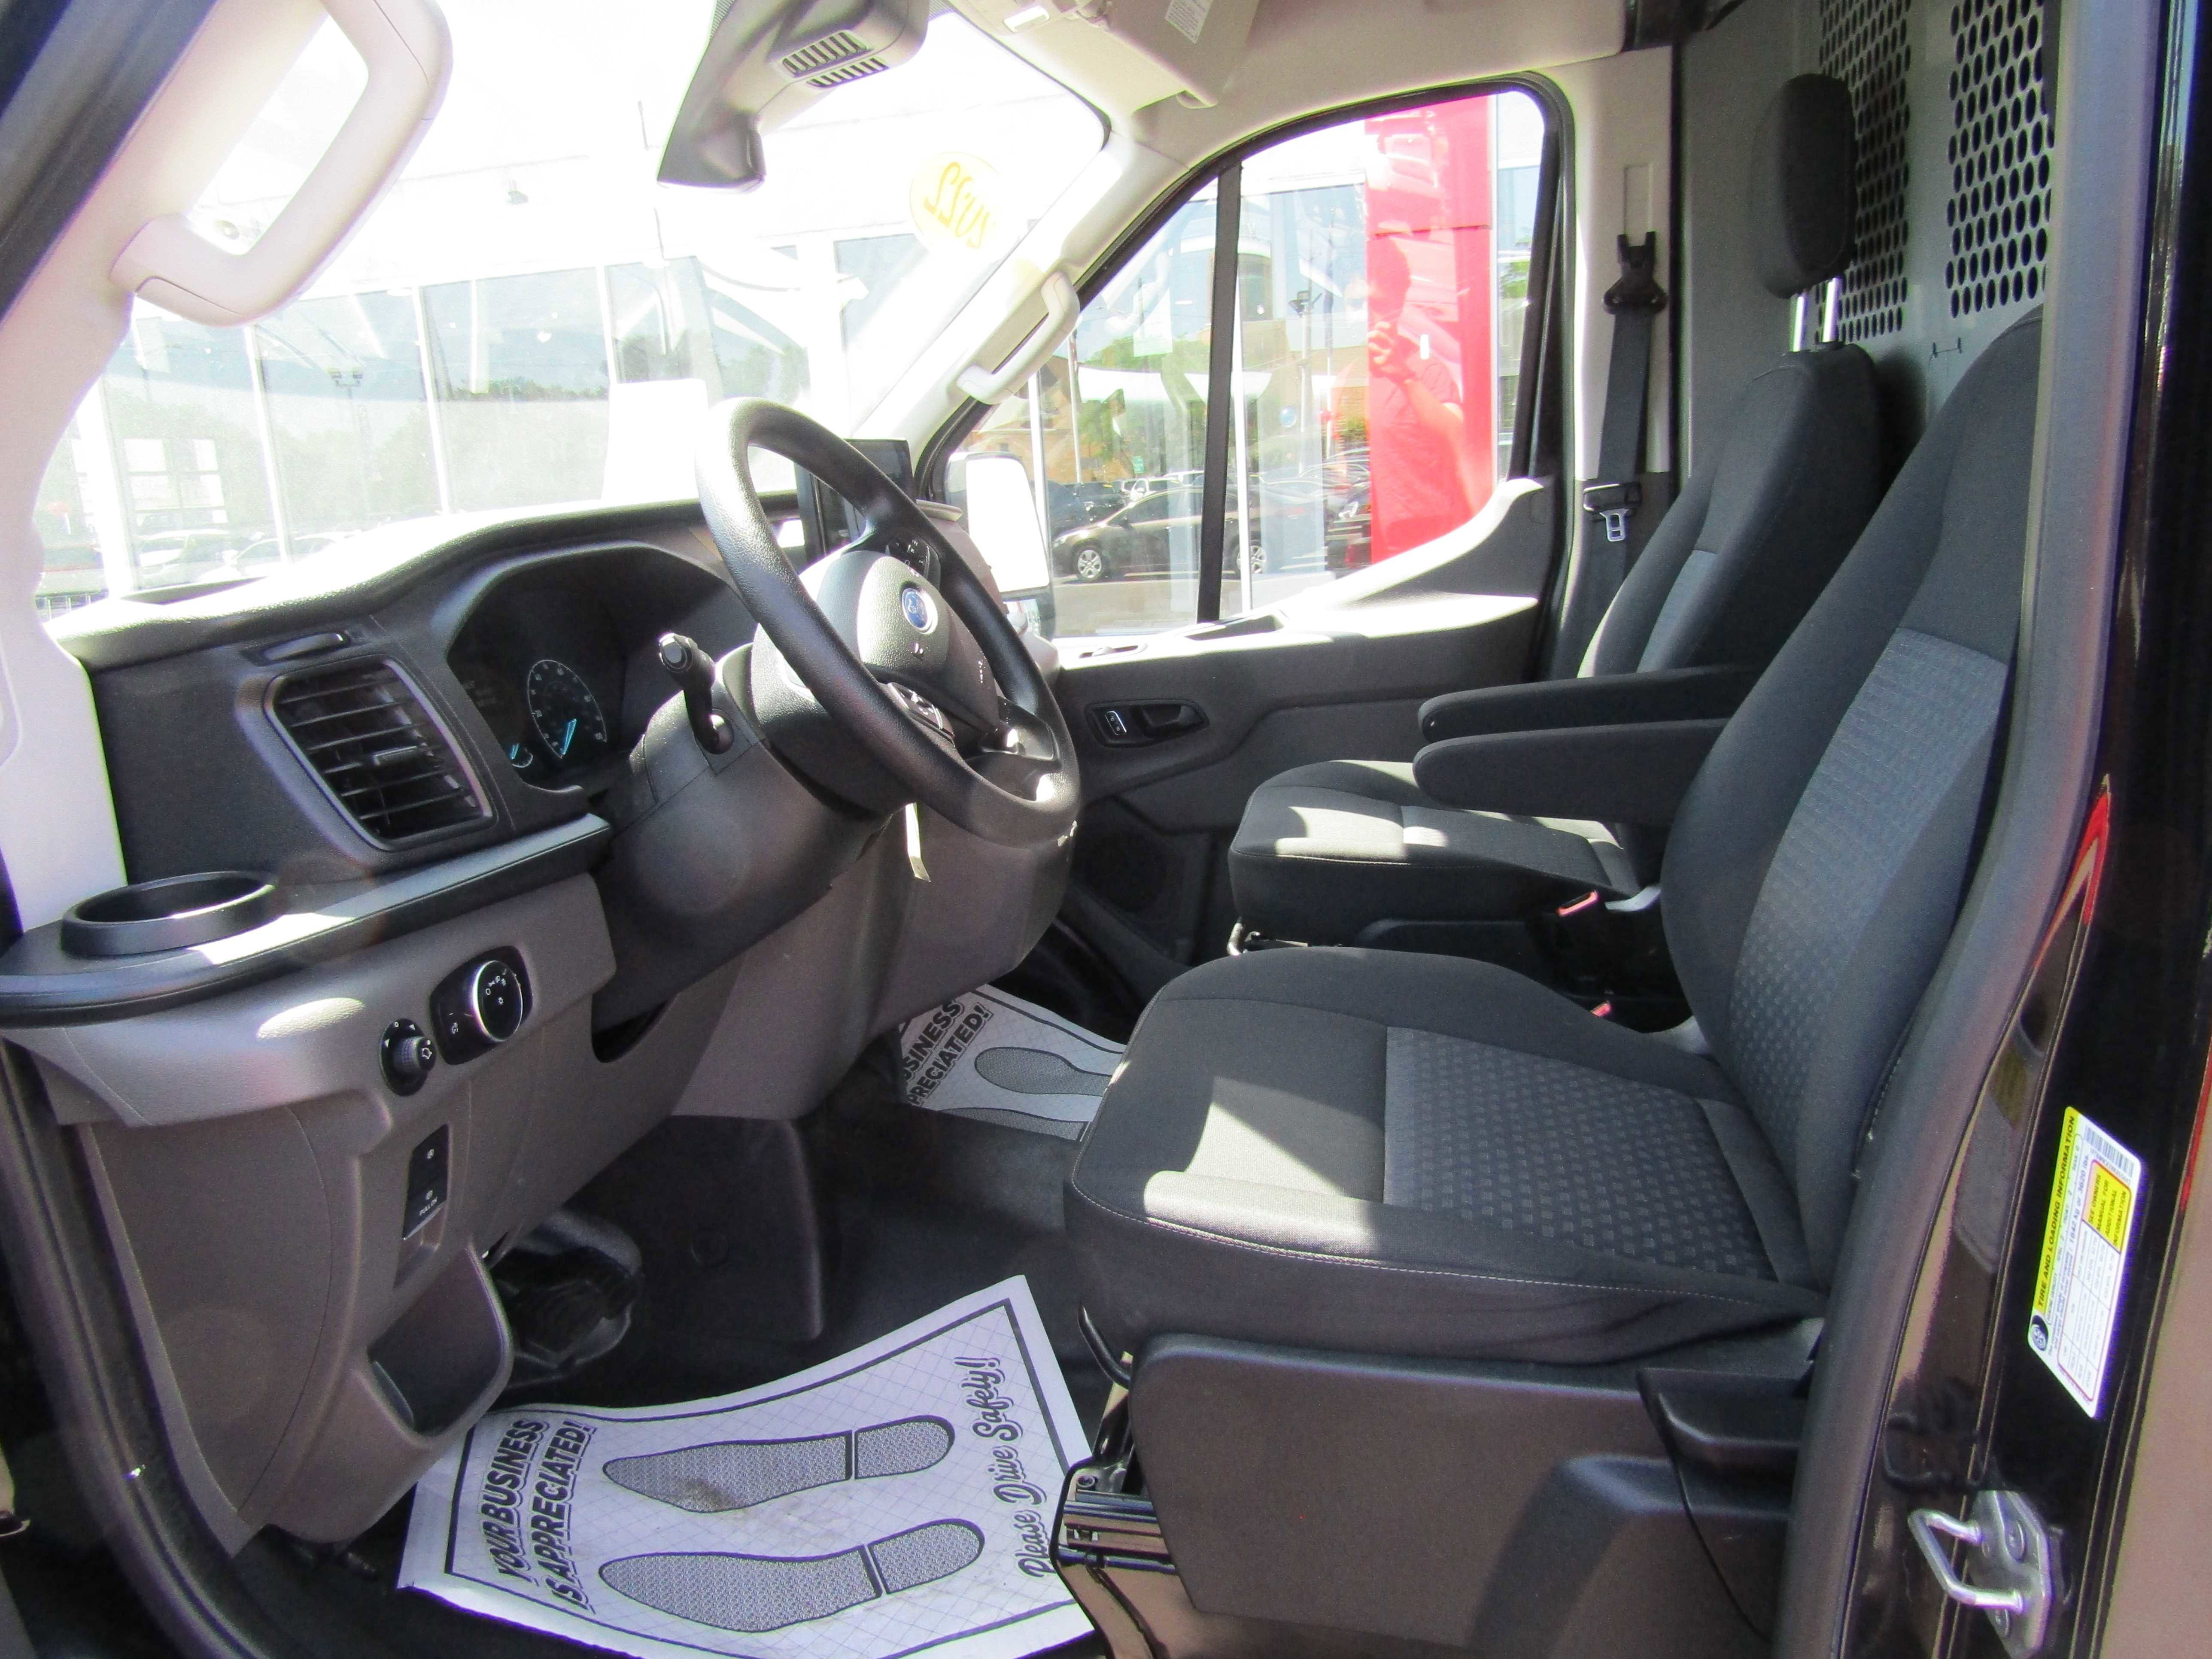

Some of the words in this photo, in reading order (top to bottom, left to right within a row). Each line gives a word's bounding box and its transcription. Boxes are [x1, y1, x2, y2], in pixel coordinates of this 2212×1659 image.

[2038, 1279, 2046, 1310] TIRE
[2042, 1252, 2051, 1280] AND
[2047, 1199, 2060, 1254] LOADING
[2056, 1114, 2075, 1199] INFORMATION
[2069, 1219, 2077, 1244] 1642
[2077, 1168, 2086, 1194] 3620
[2090, 1172, 2101, 1209] OWNERS
[2096, 1197, 2106, 1232] MANUAL
[2104, 1187, 2117, 1237] ADDITIONAL
[2112, 1189, 2127, 1248] INFORMATION
[954, 1357, 1021, 1442] Safely!
[480, 1419, 547, 1526] BUSINESS
[530, 1419, 594, 1585] APPRECIATED!
[987, 1444, 1044, 1505] Drive
[482, 1520, 536, 1584] YOUR
[1013, 1509, 1057, 1579] Please
[545, 1577, 591, 1612] IS
